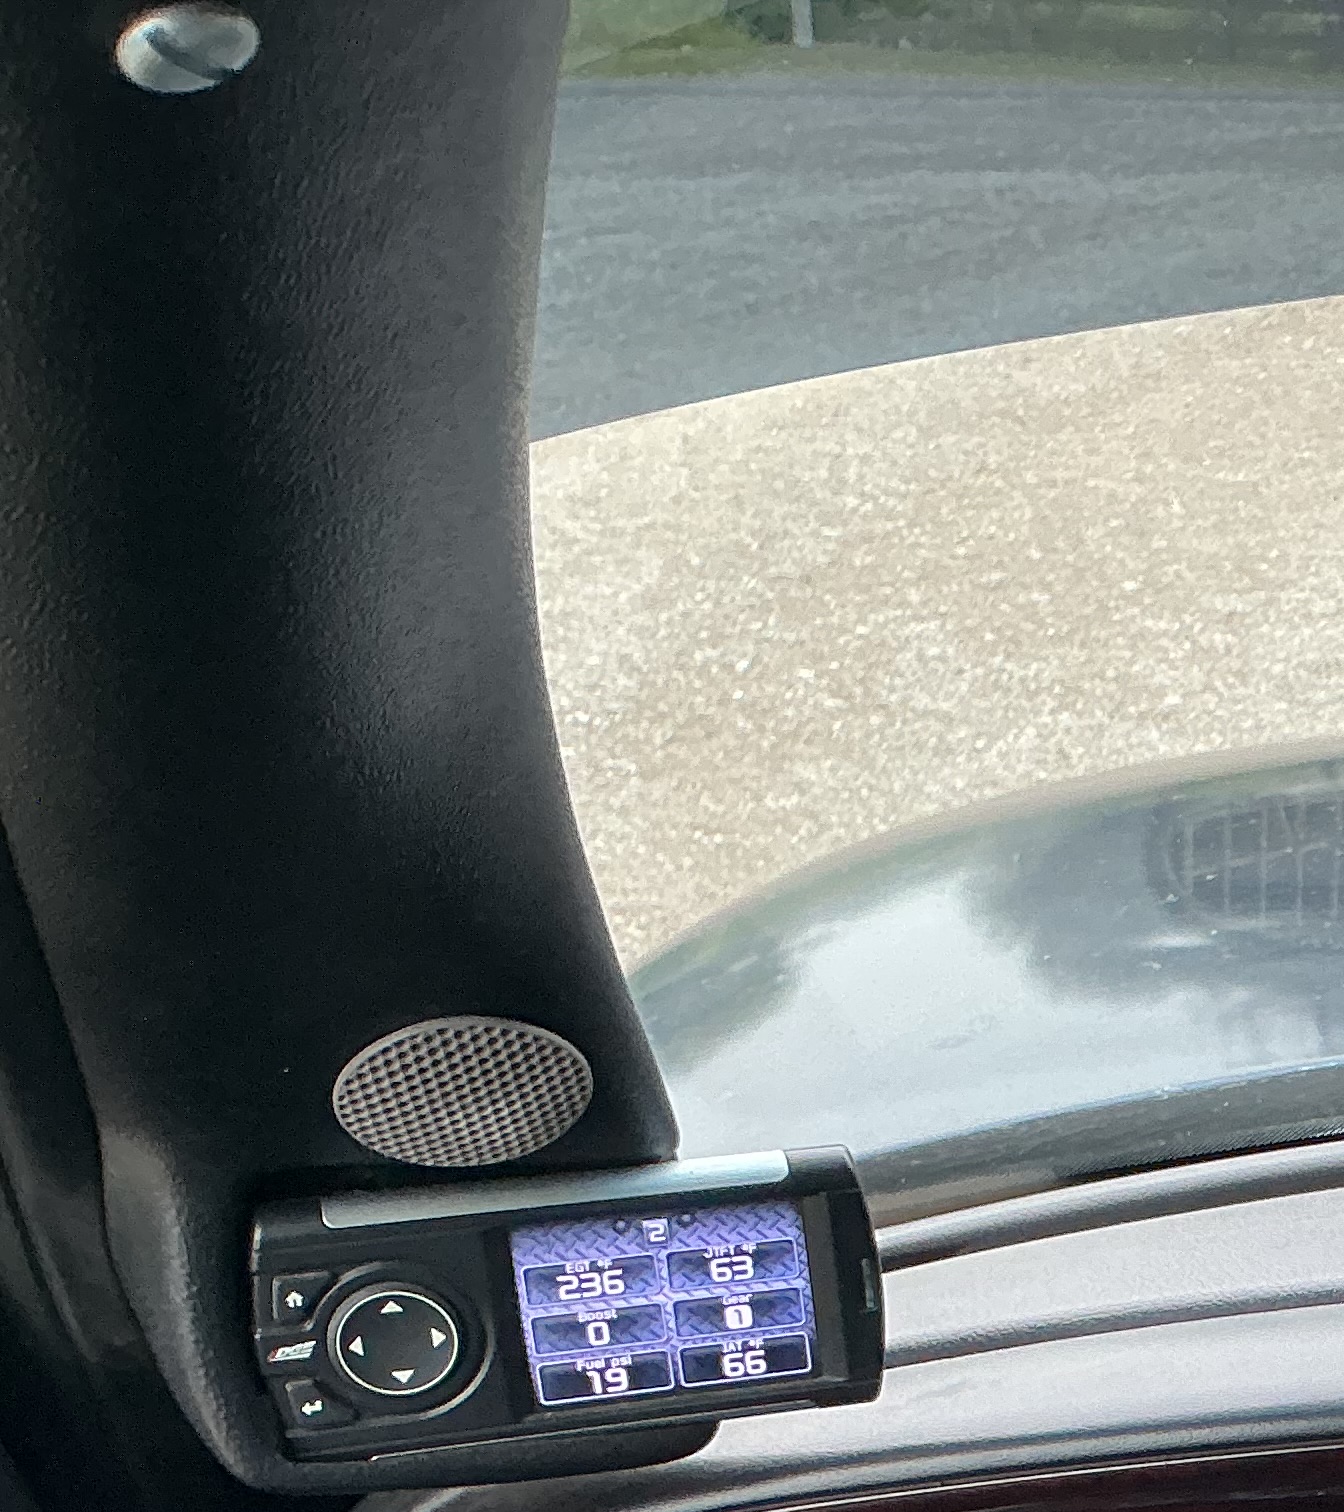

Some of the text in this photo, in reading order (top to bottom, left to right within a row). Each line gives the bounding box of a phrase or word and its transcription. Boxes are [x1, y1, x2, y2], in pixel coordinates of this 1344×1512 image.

[649, 1223, 666, 1242] 2
[565, 1261, 591, 1275] EGT
[709, 1255, 755, 1283] 63
[555, 1267, 626, 1301] 236
[586, 1320, 611, 1347] 0
[575, 1352, 632, 1372] Fuel psi
[722, 1349, 768, 1378] 66
[585, 1366, 630, 1395] 19
